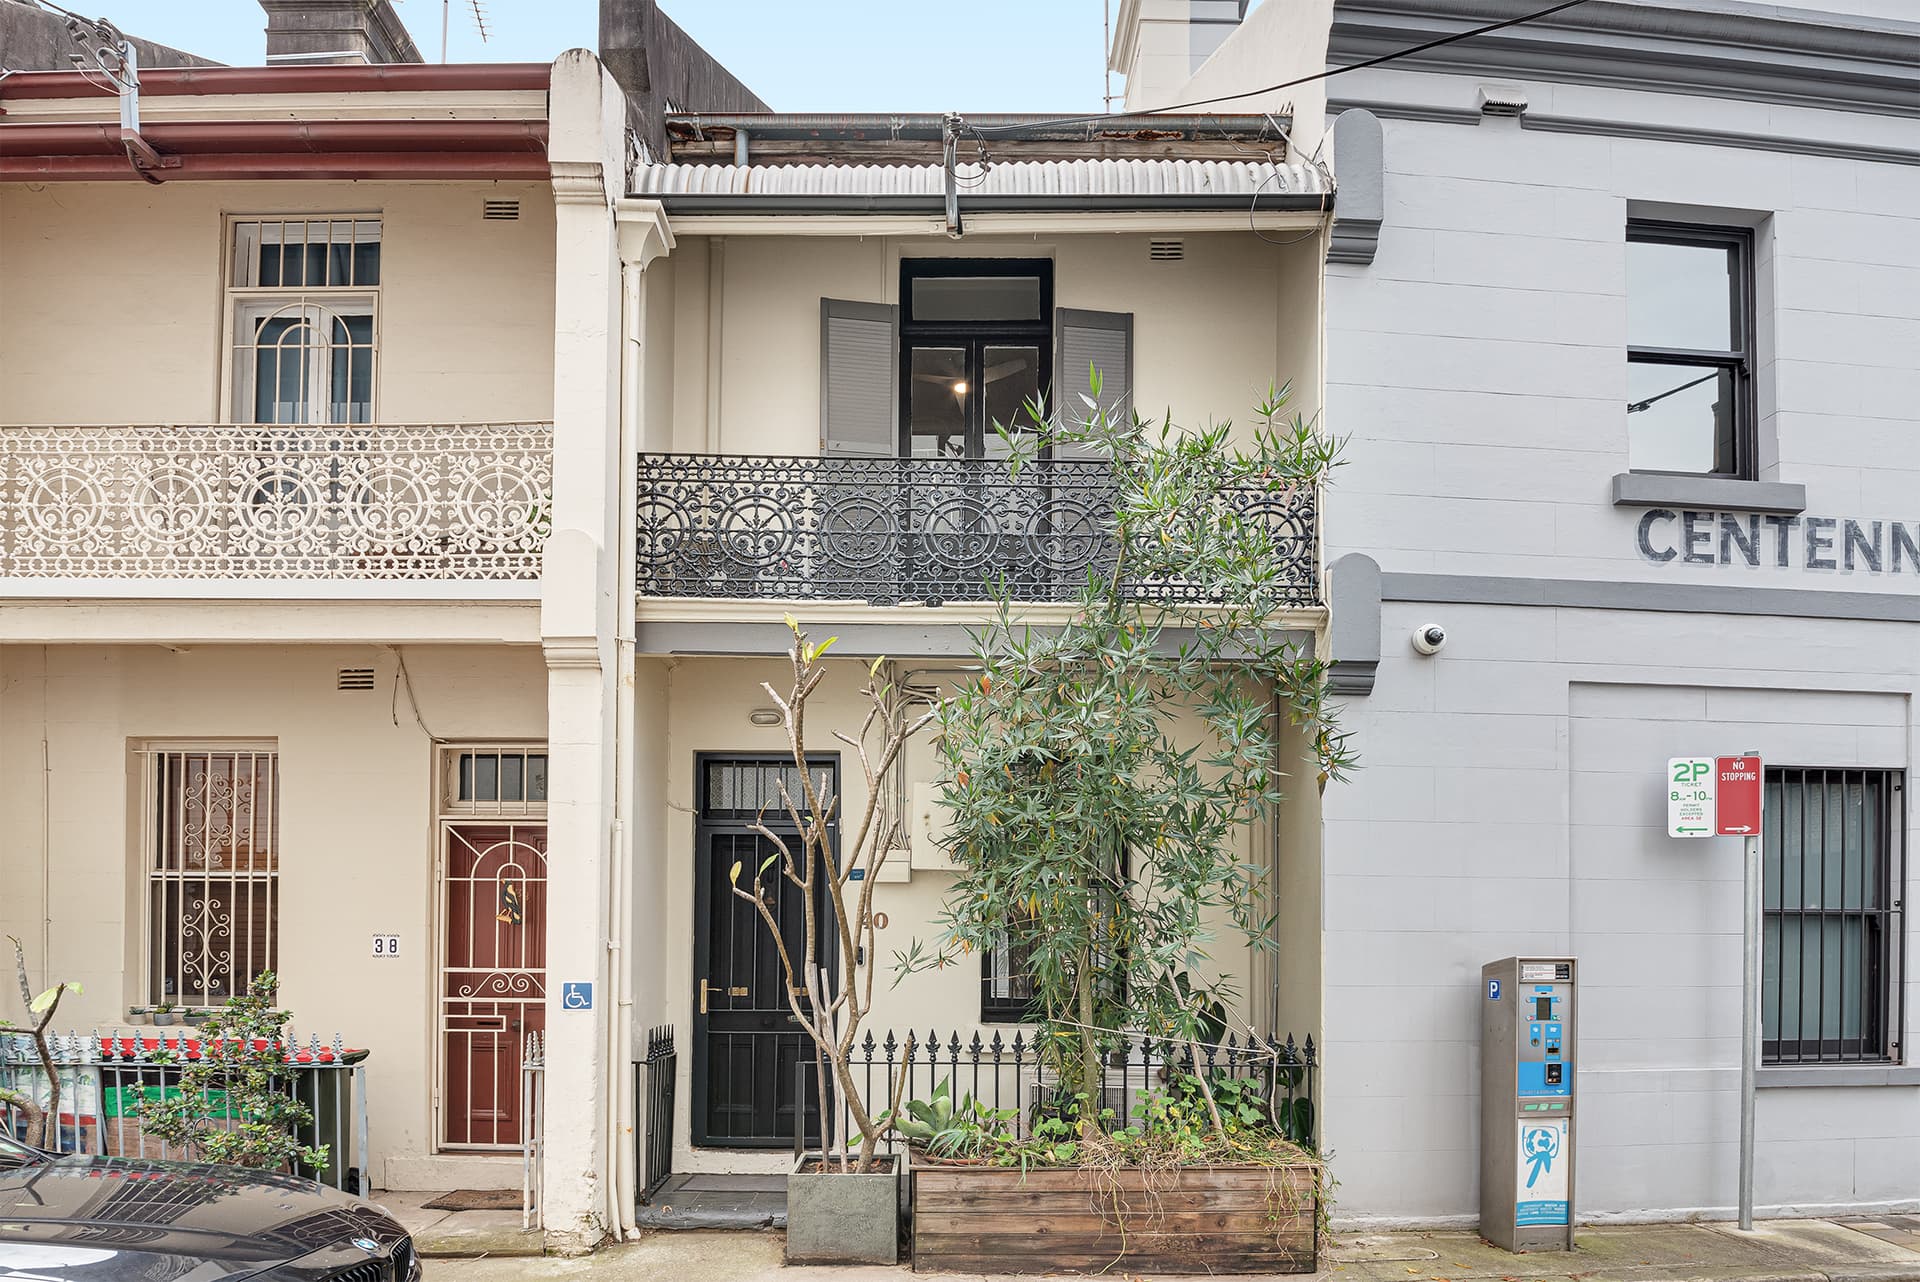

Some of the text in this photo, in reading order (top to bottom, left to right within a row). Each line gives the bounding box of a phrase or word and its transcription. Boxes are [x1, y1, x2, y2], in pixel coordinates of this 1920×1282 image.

[1637, 508, 1920, 573] CENTENN
[1673, 763, 1710, 782] 2P
[1732, 761, 1745, 770] NO
[1721, 772, 1756, 781] STOPPING
[375, 938, 397, 953] 38
[1489, 981, 1499, 998] P
